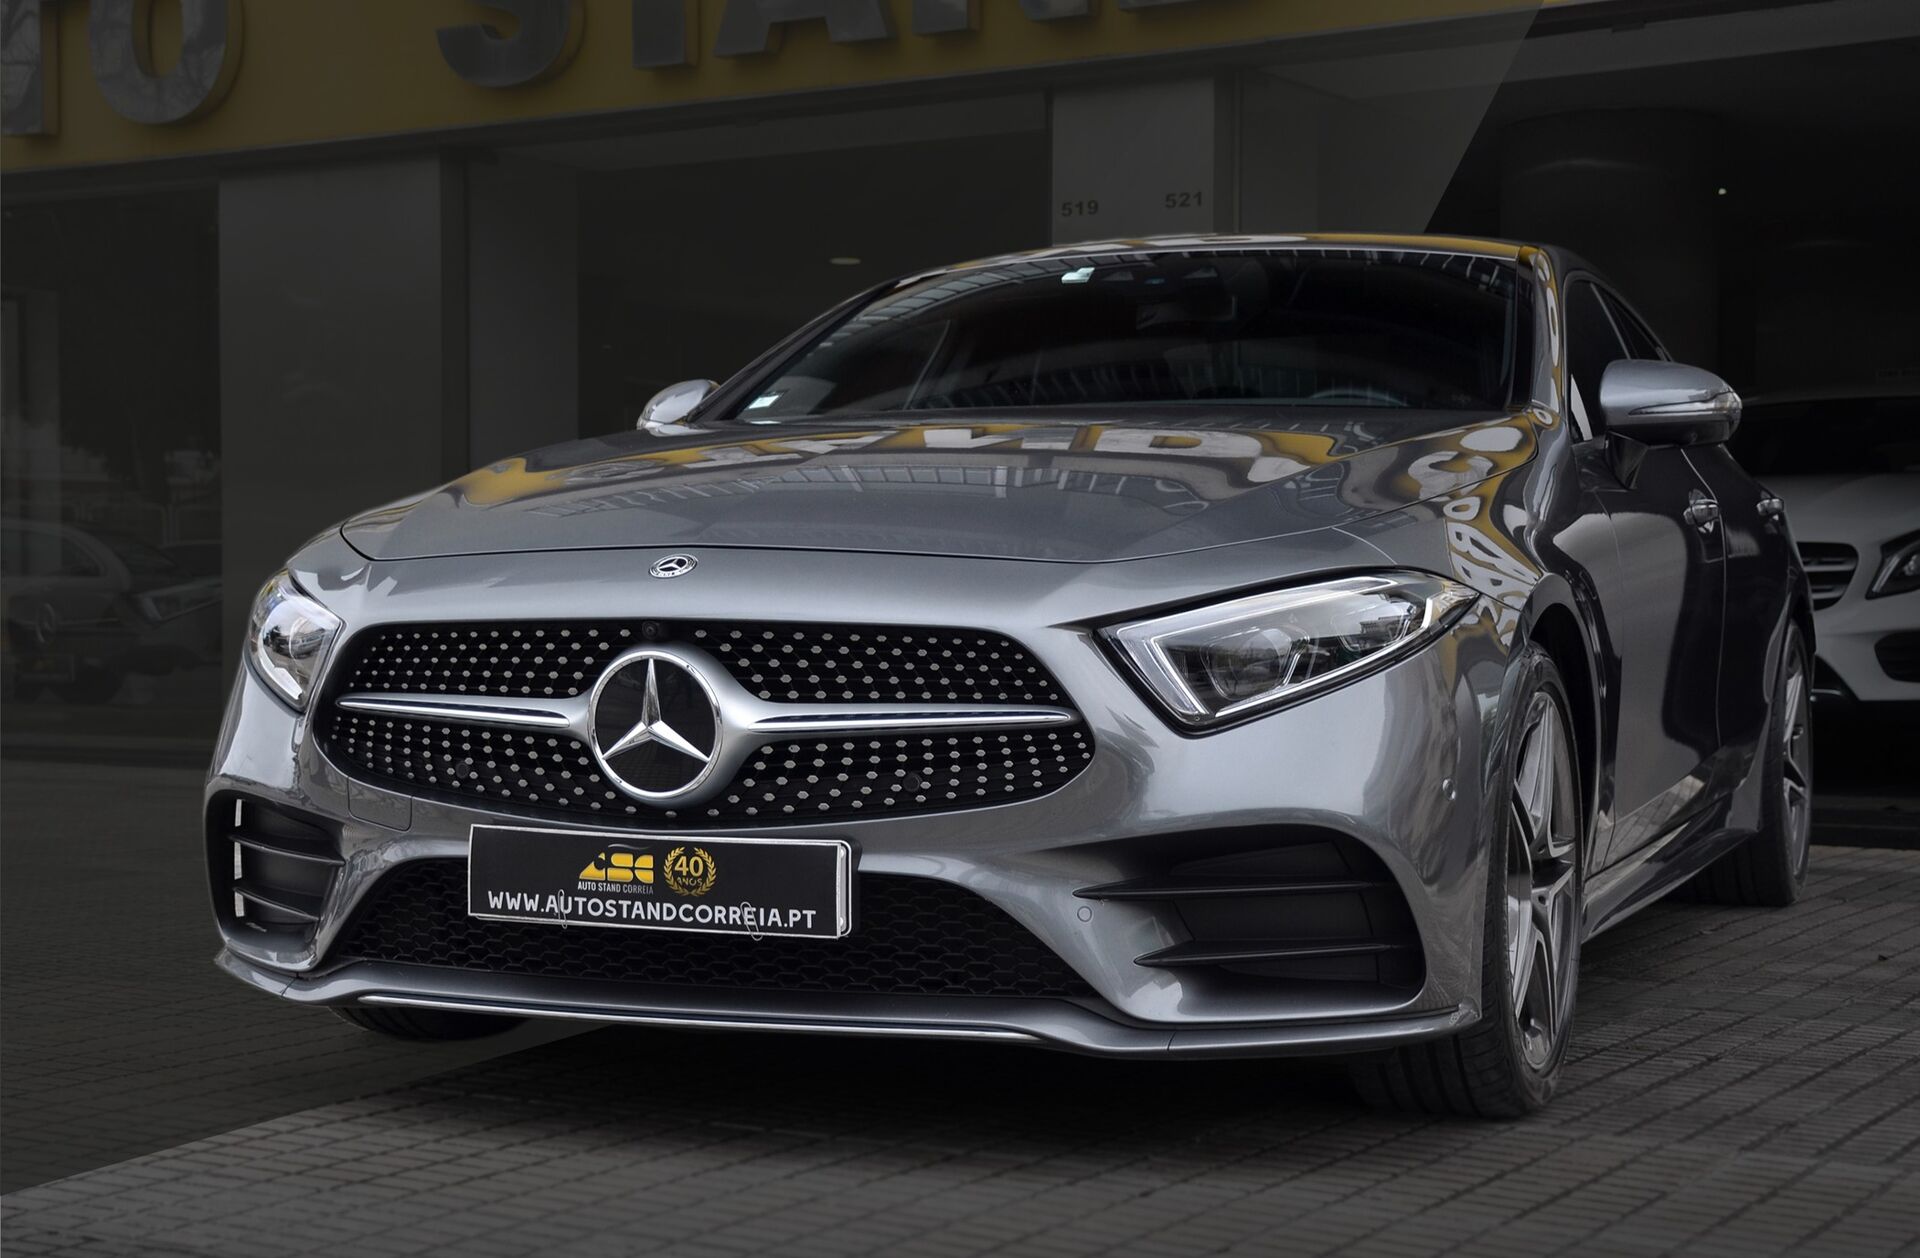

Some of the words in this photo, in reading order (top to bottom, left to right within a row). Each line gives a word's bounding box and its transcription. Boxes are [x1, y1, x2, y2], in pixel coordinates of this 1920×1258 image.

[1061, 200, 1099, 217] 519
[1165, 191, 1203, 209] 521
[674, 855, 704, 877] 40
[577, 881, 597, 892] AUTO
[598, 882, 621, 894] STAND
[622, 884, 654, 895] CORREIA
[487, 890, 817, 929] WWW.AUTOSTANDCORREIA.PT
